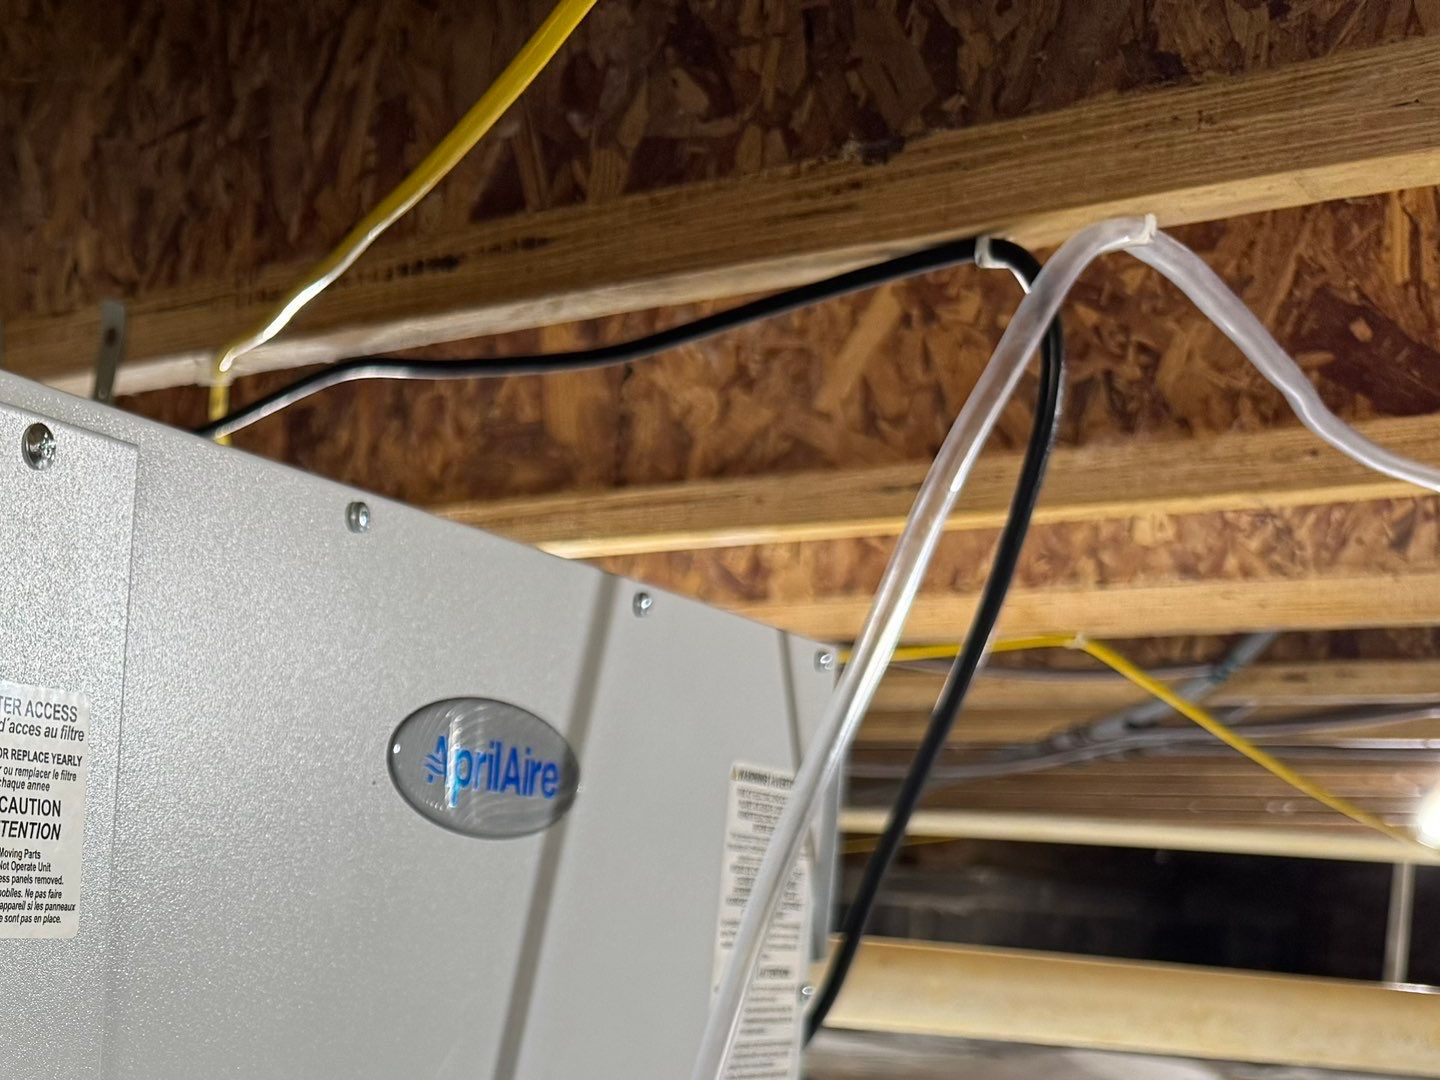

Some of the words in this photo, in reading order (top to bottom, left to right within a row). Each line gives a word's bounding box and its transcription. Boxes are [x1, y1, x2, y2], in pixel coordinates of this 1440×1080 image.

[25, 700, 77, 722] ACCESS
[44, 726, 58, 739] au
[60, 725, 84, 742] filtre
[11, 748, 49, 763] REPLACE
[51, 752, 82, 767] YEARLY
[3, 766, 13, 776] ou
[15, 767, 51, 779] remplacer
[52, 769, 59, 780] le
[60, 769, 77, 781] filtre
[424, 735, 560, 808] AprilAire
[27, 781, 50, 791] annee
[24, 849, 41, 859] Parts
[11, 861, 36, 873] Operate
[38, 862, 51, 872] Unit
[11, 874, 33, 885] panels
[35, 875, 64, 885] removed.
[25, 889, 33, 898] Ne
[35, 890, 46, 900] pas
[48, 889, 62, 899] faire
[27, 901, 33, 910] si
[34, 901, 43, 911] les
[44, 903, 76, 913] panneaux
[4, 914, 20, 923] sont
[20, 915, 32, 925] pas
[34, 915, 42, 923] en
